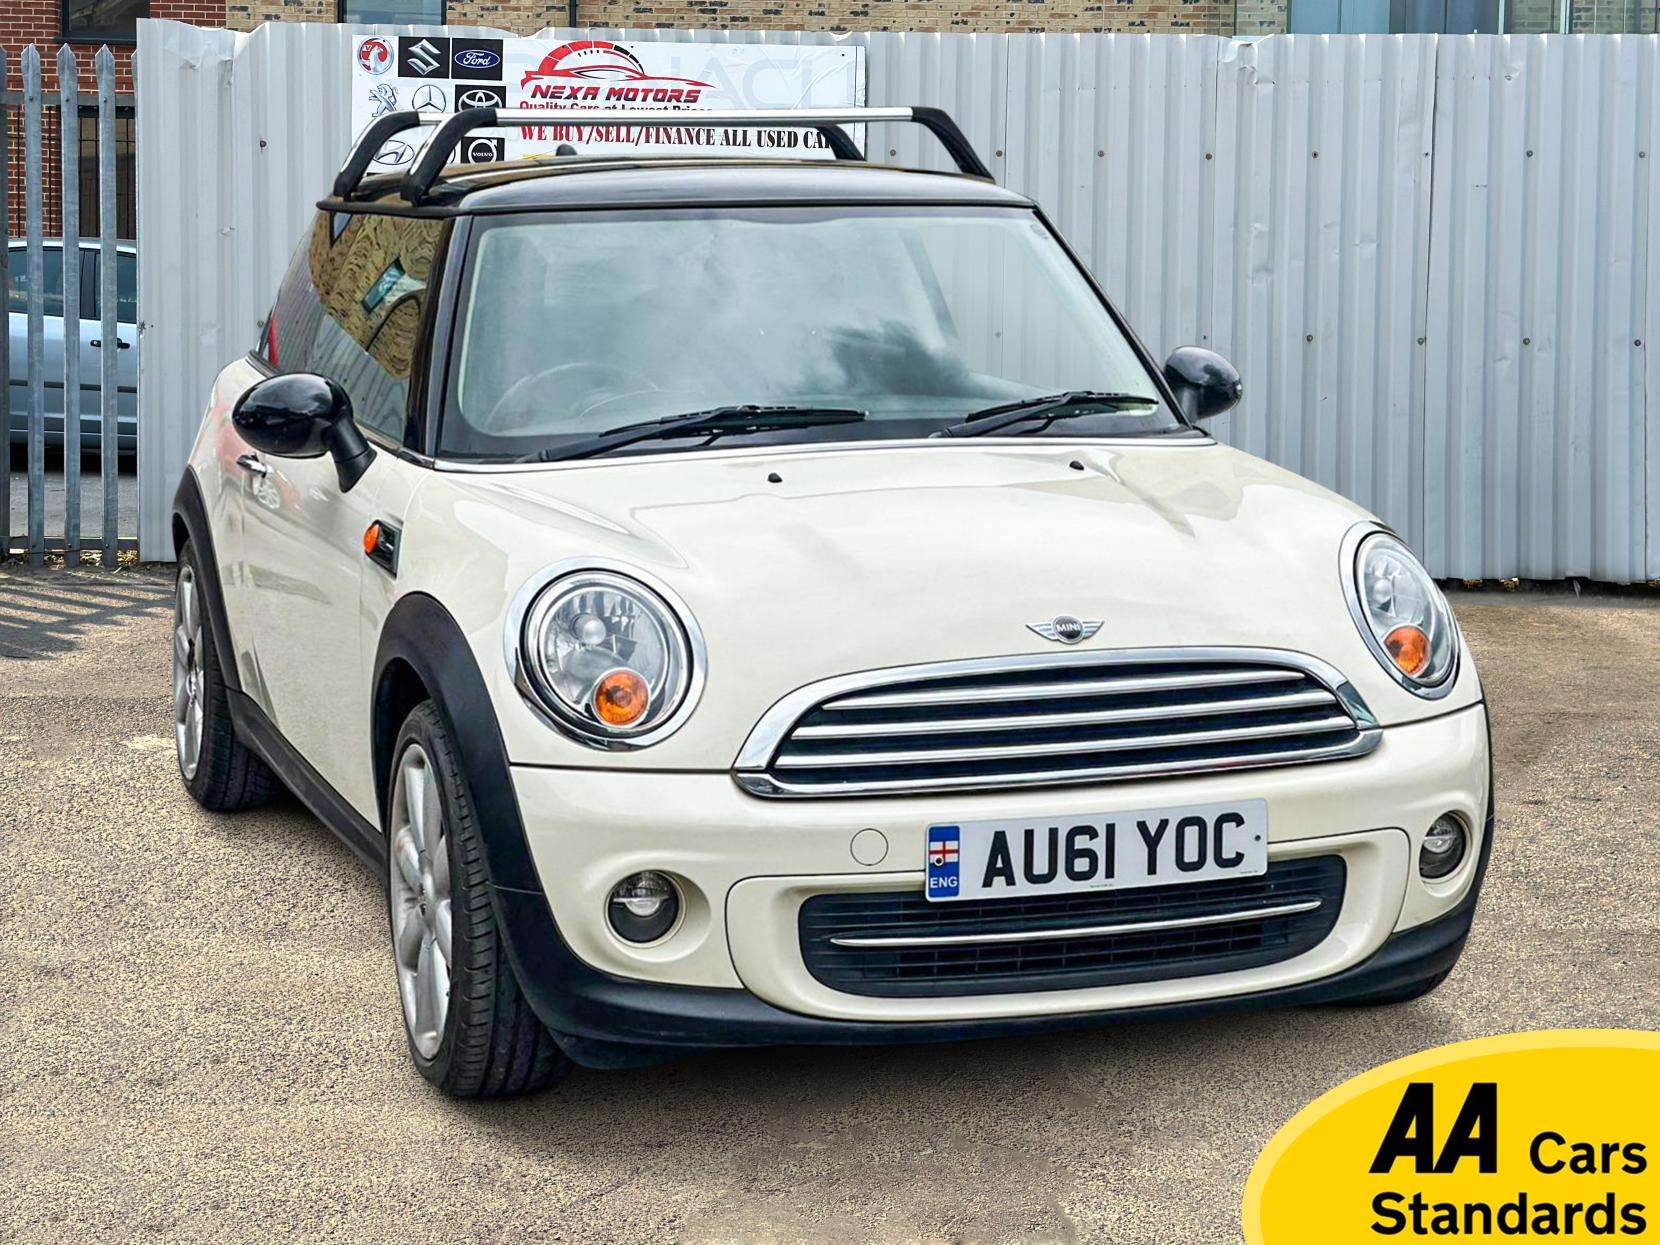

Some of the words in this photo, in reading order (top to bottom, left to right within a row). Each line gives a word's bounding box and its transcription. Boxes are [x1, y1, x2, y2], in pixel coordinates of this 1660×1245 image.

[462, 52, 491, 65] Ford
[531, 85, 600, 100] NEXA
[605, 87, 702, 104] MOTORS
[520, 124, 547, 141] WE
[552, 125, 716, 147] BUY/SELL/FINANCE
[720, 129, 751, 147] ALL
[757, 130, 799, 148] USED
[1055, 623, 1080, 632] MINI
[982, 823, 1116, 888] AU61
[1136, 812, 1246, 876] YOC
[930, 876, 958, 889] ENG
